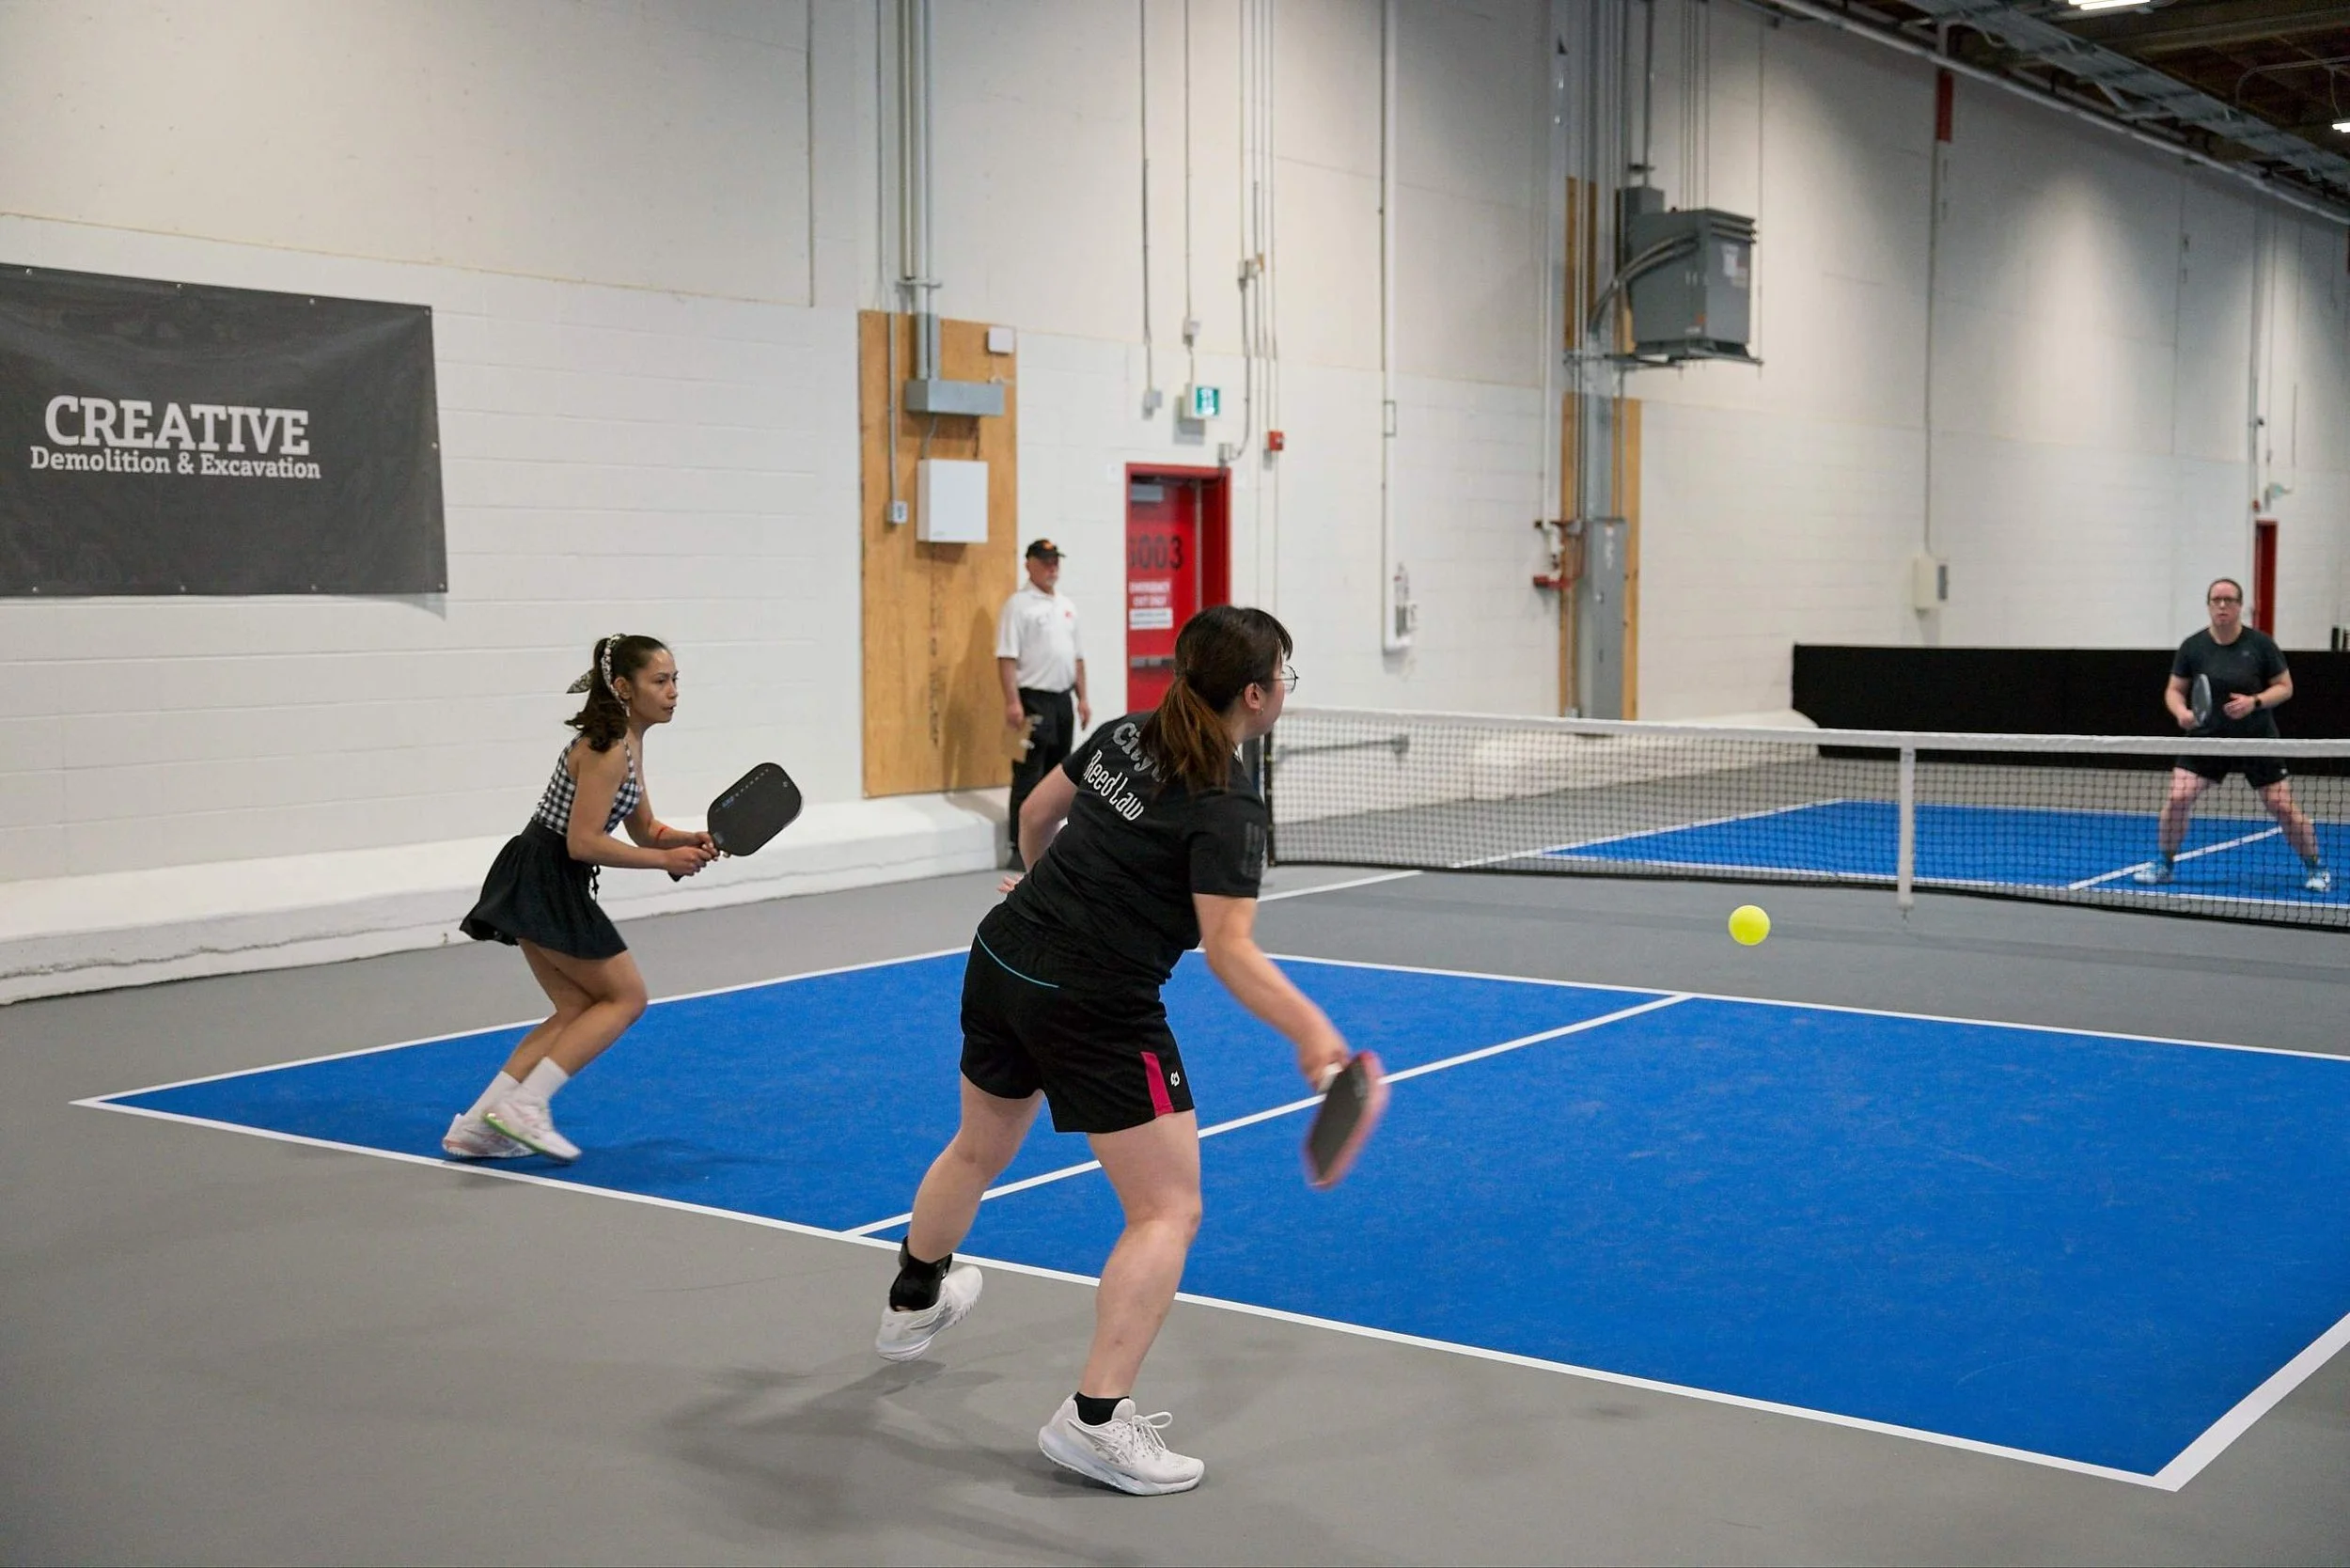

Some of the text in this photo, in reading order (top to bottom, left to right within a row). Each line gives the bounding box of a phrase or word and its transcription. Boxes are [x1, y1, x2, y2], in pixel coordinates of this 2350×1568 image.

[44, 395, 309, 456] CREATIVE
[30, 446, 321, 479] Demolition & Excavation
